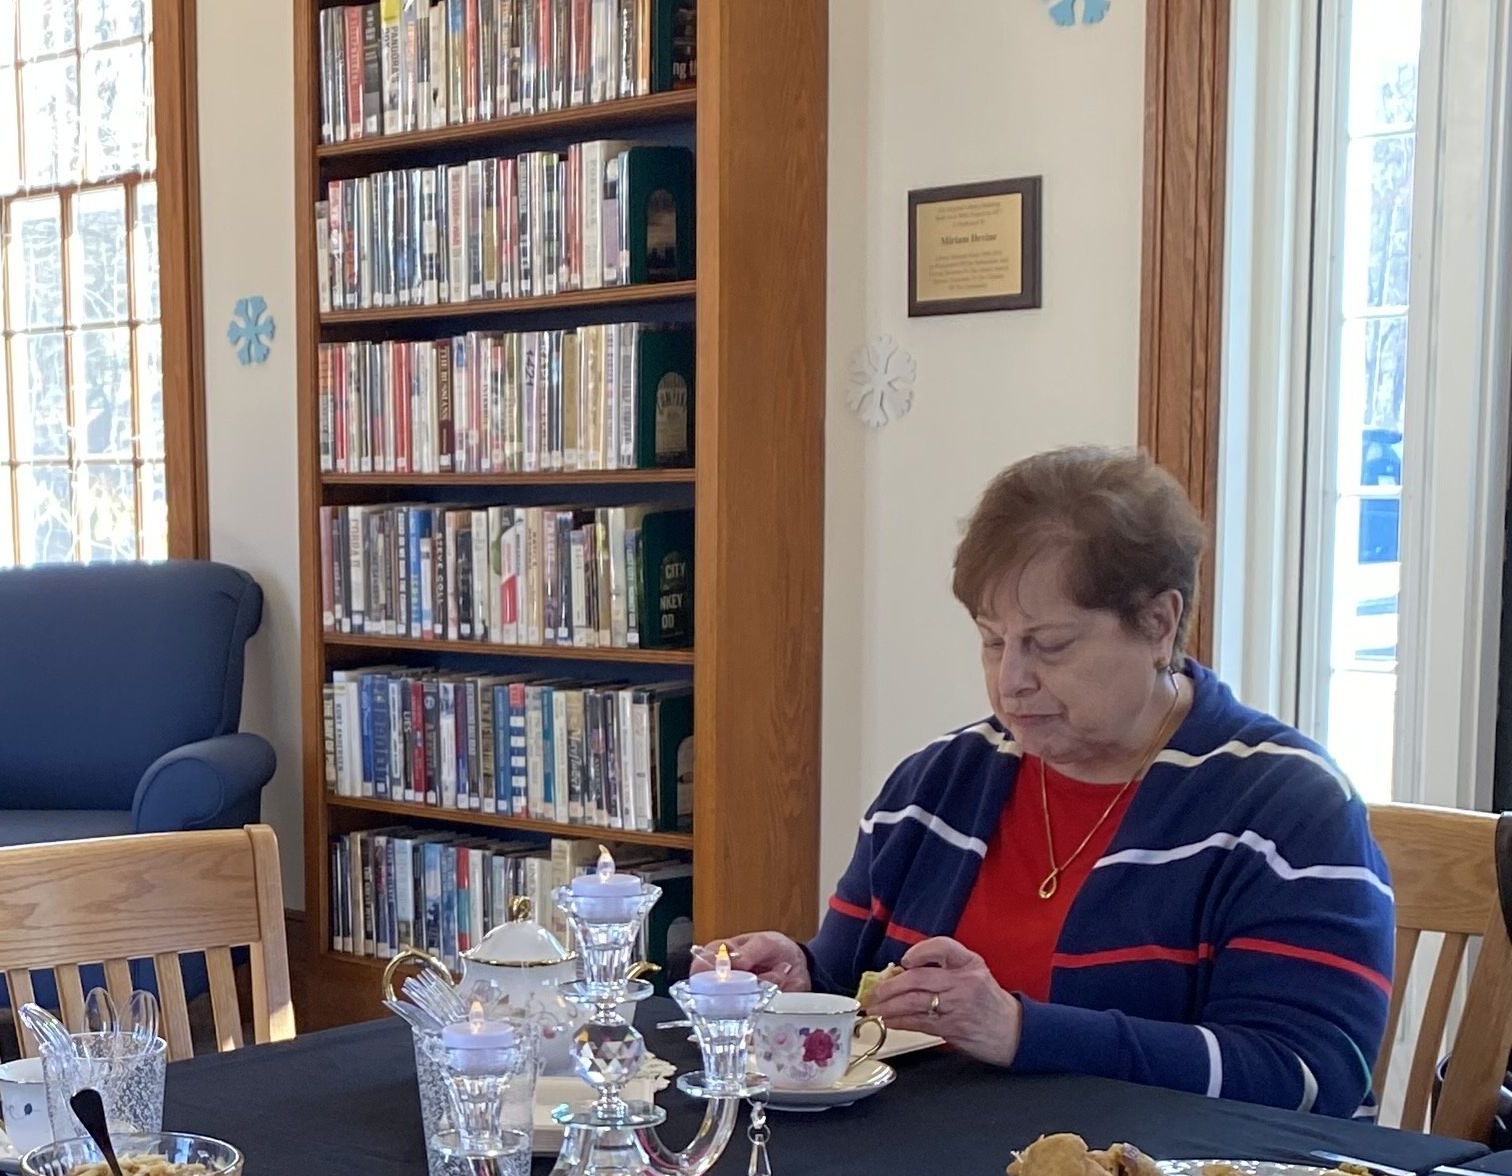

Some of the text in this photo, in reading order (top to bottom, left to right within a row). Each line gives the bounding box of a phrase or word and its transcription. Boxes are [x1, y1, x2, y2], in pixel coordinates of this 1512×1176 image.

[390, 26, 400, 83] PANDORA'S
[525, 350, 535, 386] 1421
[439, 371, 450, 421] RUSSIANS
[436, 532, 444, 605] STEVE COLL
[665, 562, 686, 579] CITY
[403, 710, 411, 732] LIES
[569, 728, 582, 791] Mayflower
